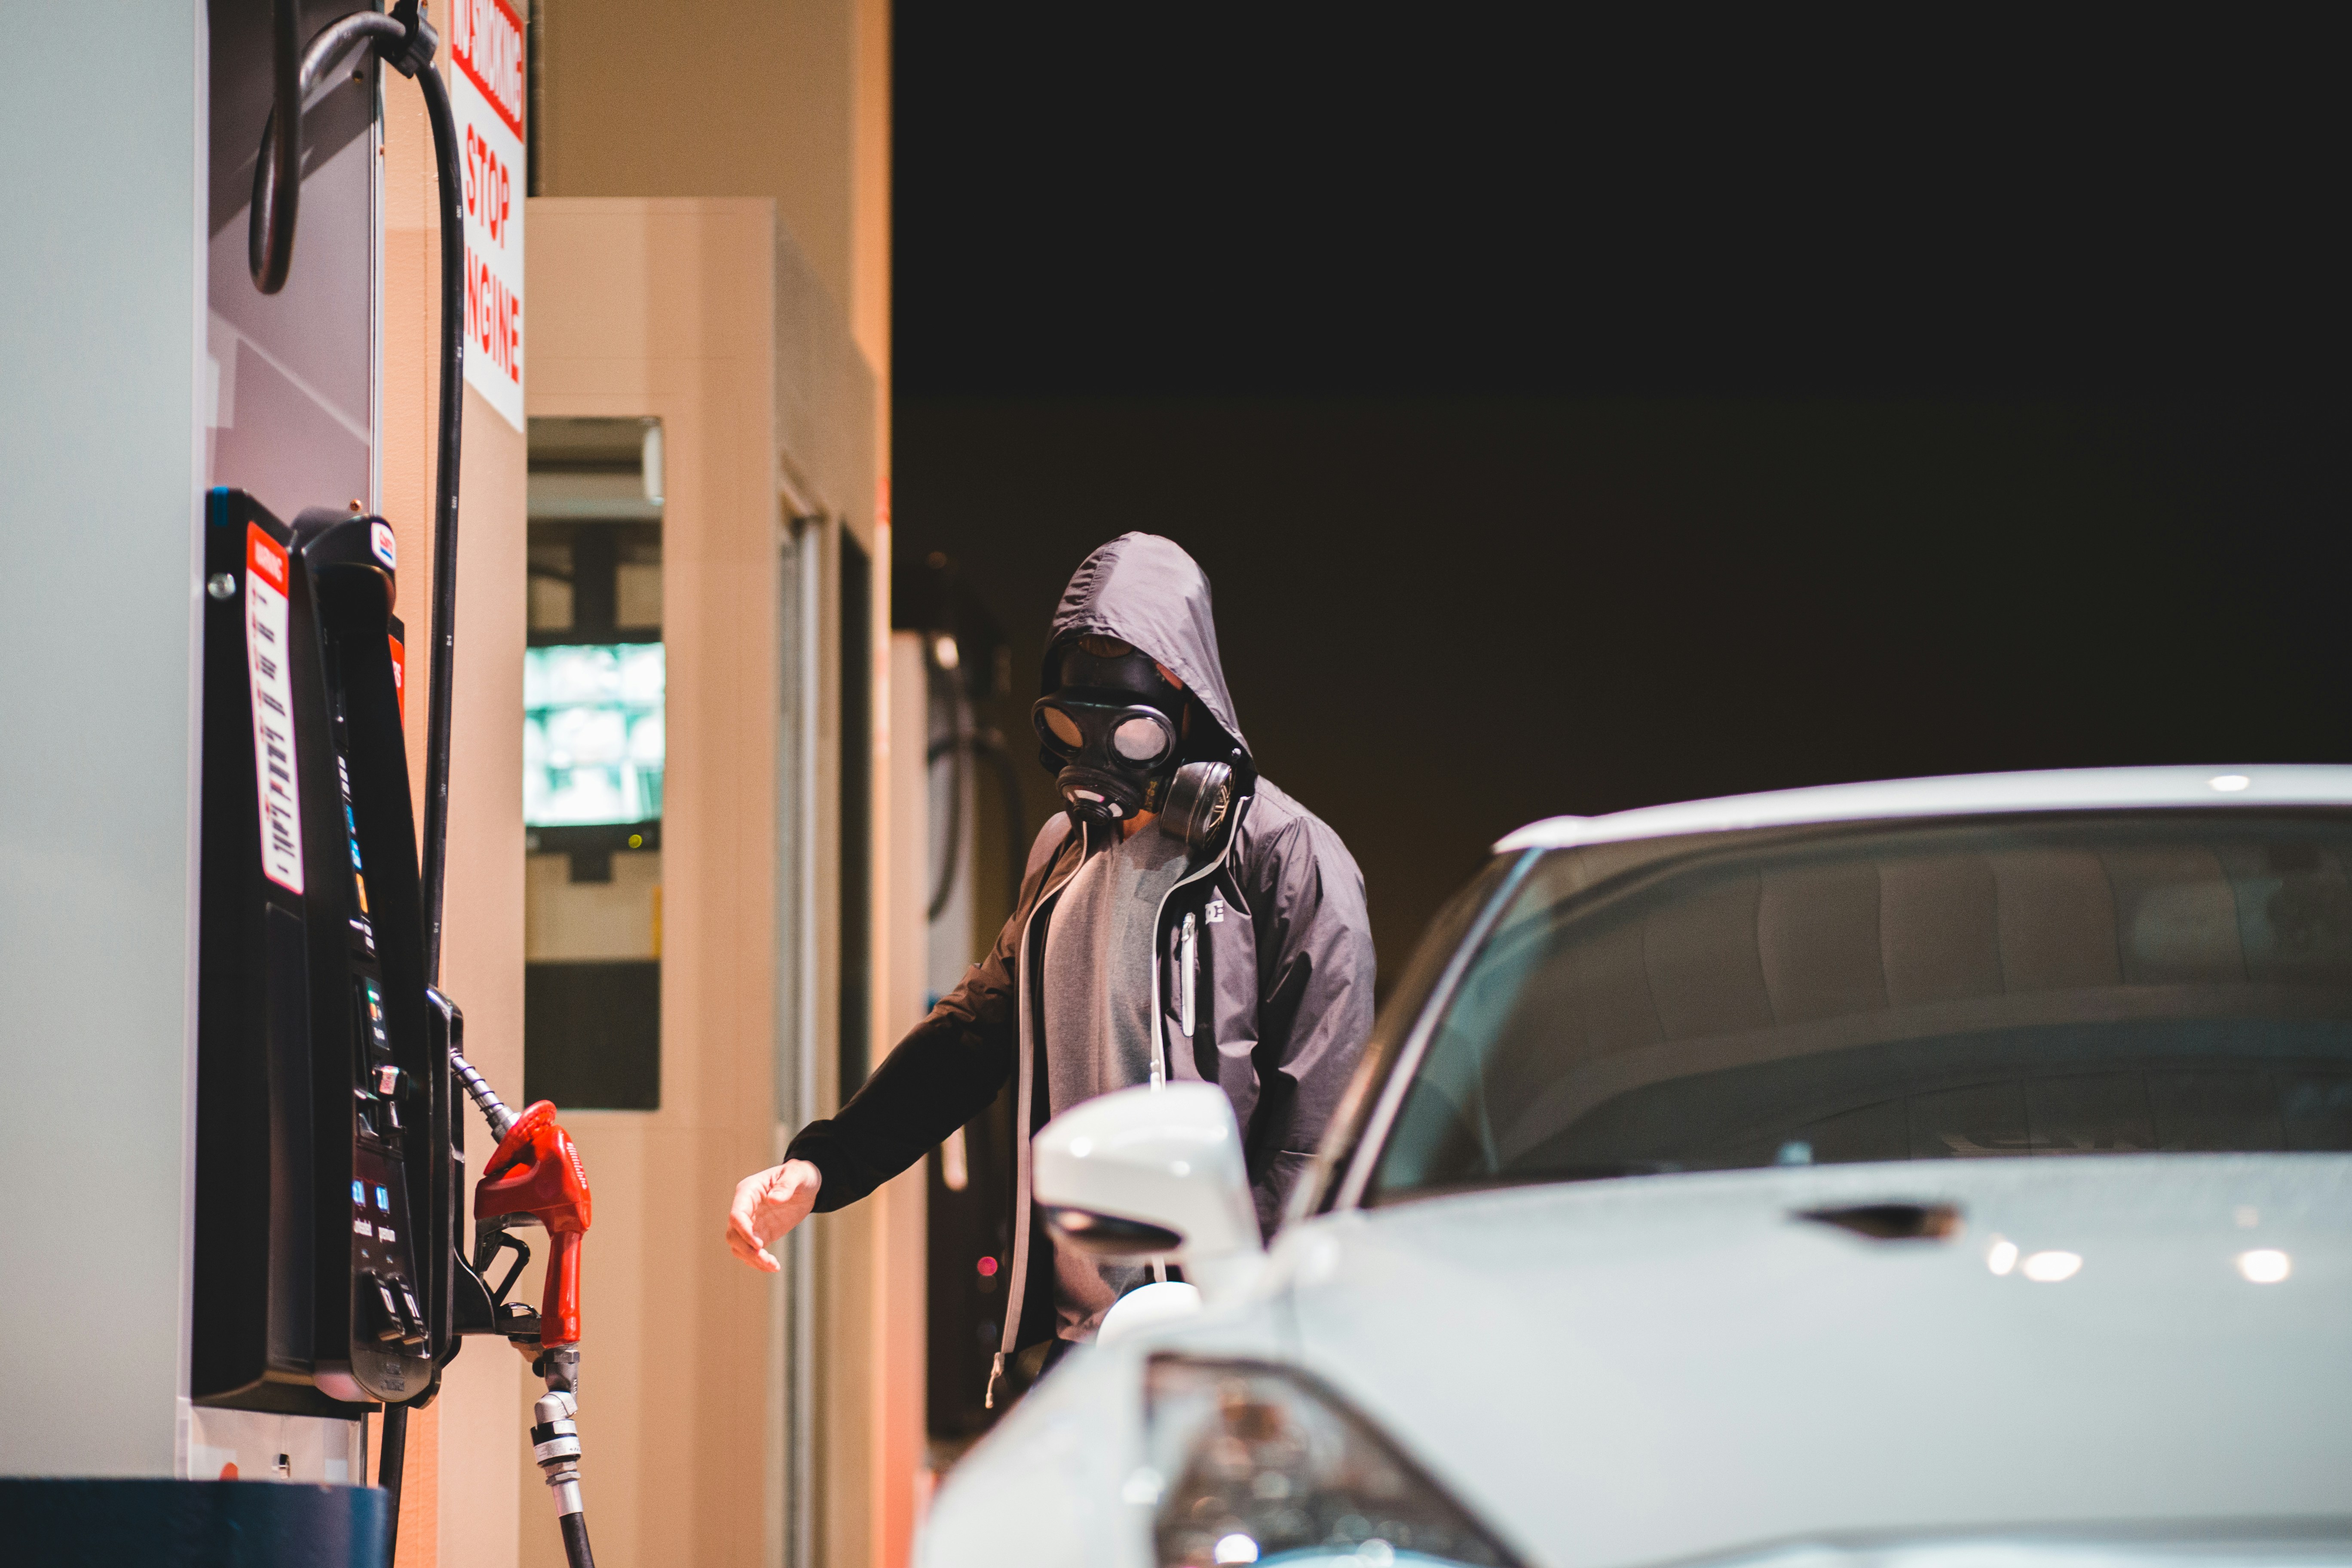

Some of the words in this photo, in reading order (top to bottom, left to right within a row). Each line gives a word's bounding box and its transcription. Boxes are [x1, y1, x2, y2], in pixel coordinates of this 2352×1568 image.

[466, 122, 510, 250] STOP
[464, 242, 519, 384] NGINE
[1205, 900, 1224, 925] DC
[404, 1292, 420, 1318] 91
